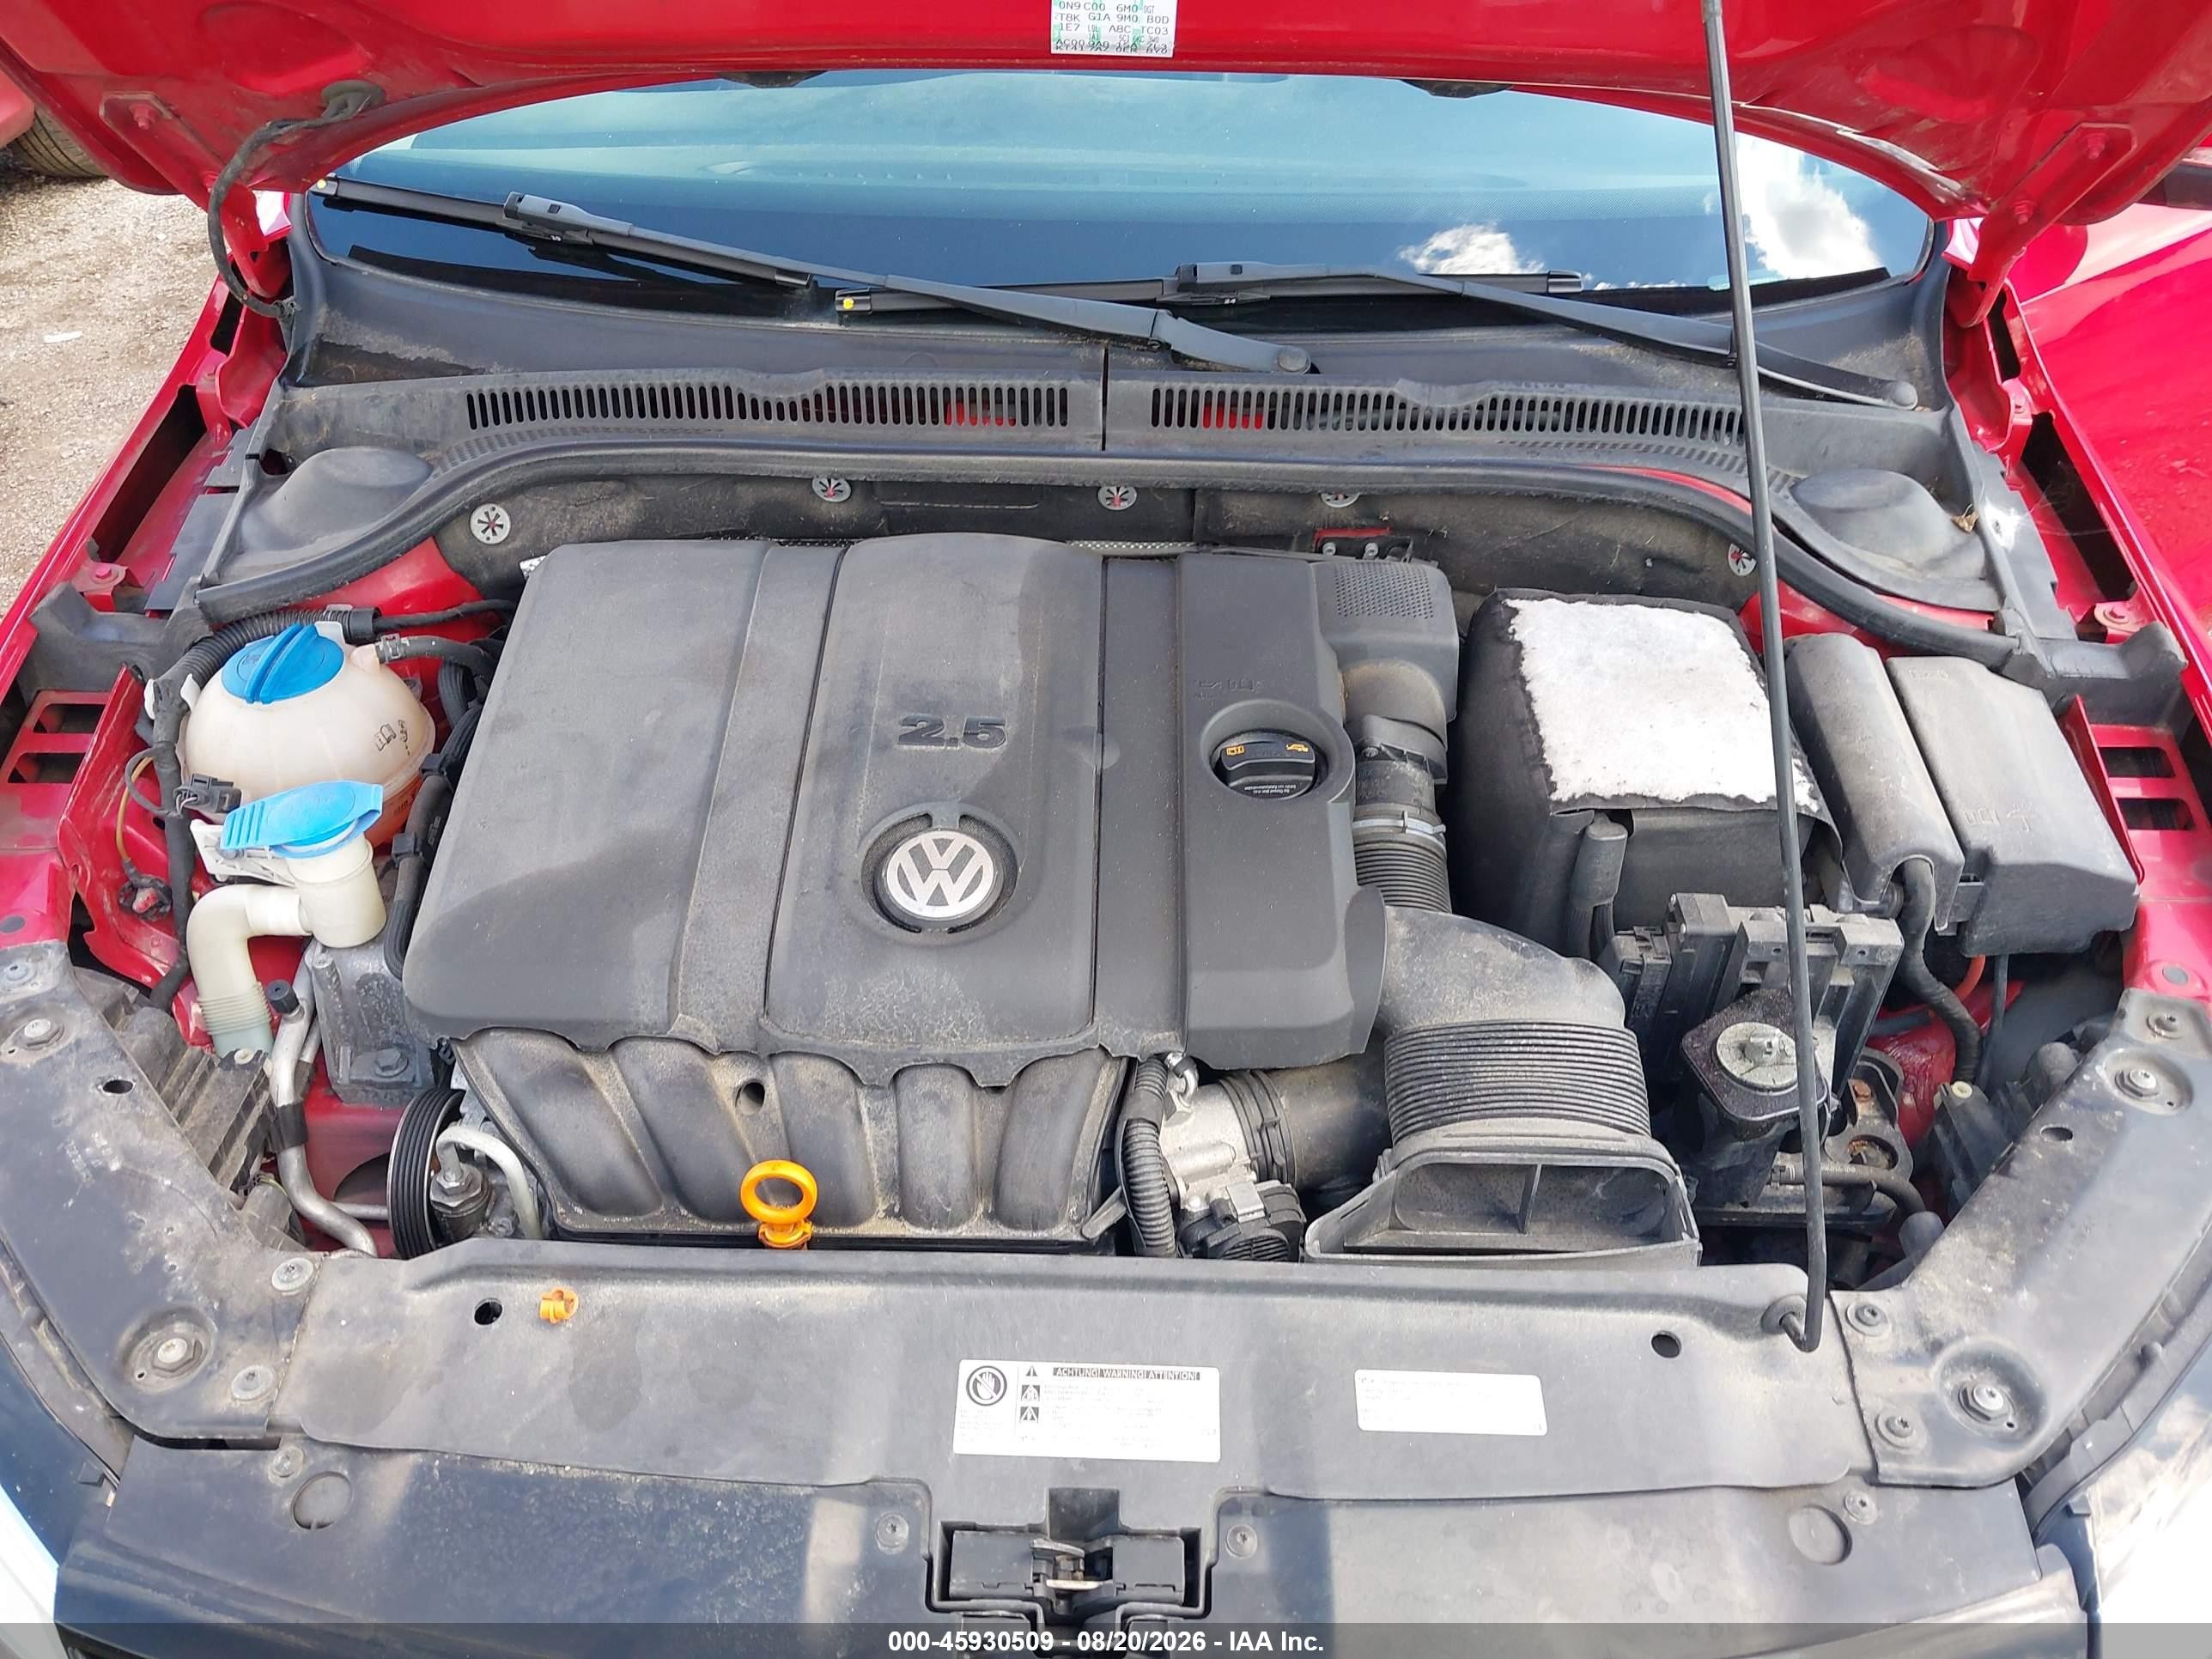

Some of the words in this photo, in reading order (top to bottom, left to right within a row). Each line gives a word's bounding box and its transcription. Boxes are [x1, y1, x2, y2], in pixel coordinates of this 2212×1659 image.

[1060, 13, 1080, 21] T8K
[898, 714, 1006, 748] 2.5
[1056, 1368, 1100, 1377] ACHTUNG!
[1103, 1370, 1146, 1378] WARNING!
[1148, 1371, 1198, 1380] ATTENTION!
